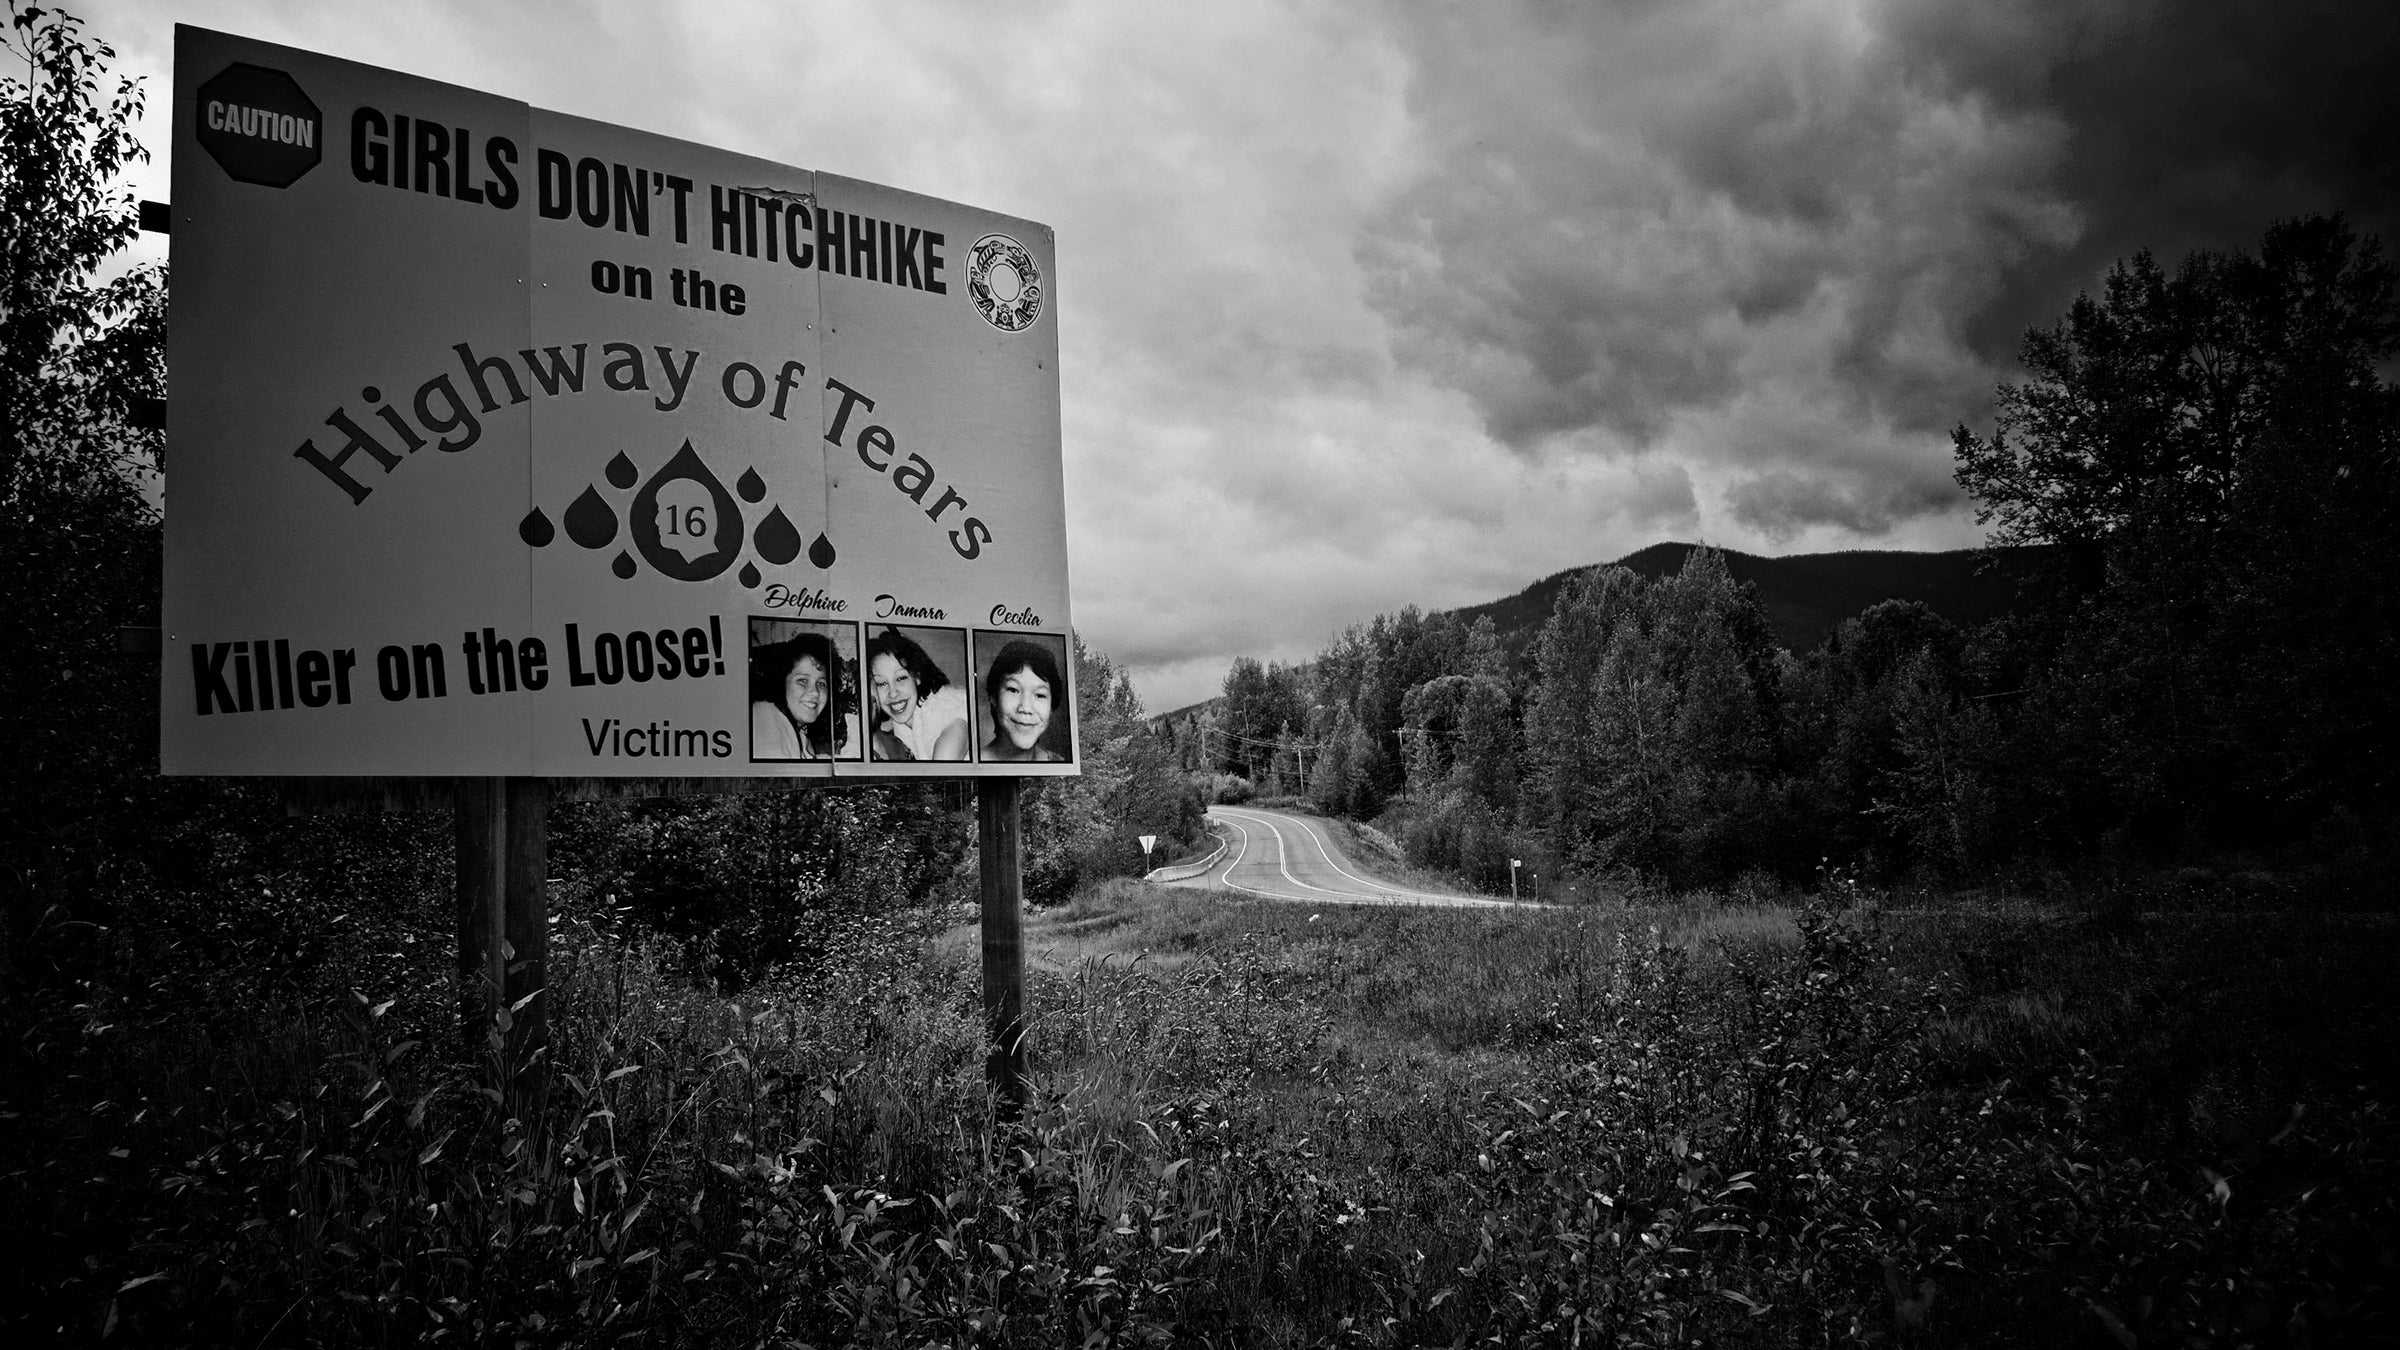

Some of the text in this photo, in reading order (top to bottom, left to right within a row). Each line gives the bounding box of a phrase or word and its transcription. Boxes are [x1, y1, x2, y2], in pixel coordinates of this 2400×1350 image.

[207, 100, 314, 148] CAUTION
[351, 106, 947, 295] GIRLS DON'T HITCHHIKE
[591, 260, 746, 316] on the
[293, 341, 992, 560] Highway of Tears
[666, 504, 707, 537] 16
[764, 584, 1043, 627] Delphine Tamara Cecilia
[191, 614, 726, 716] Killer on the Loose!
[581, 717, 733, 758] Victims
